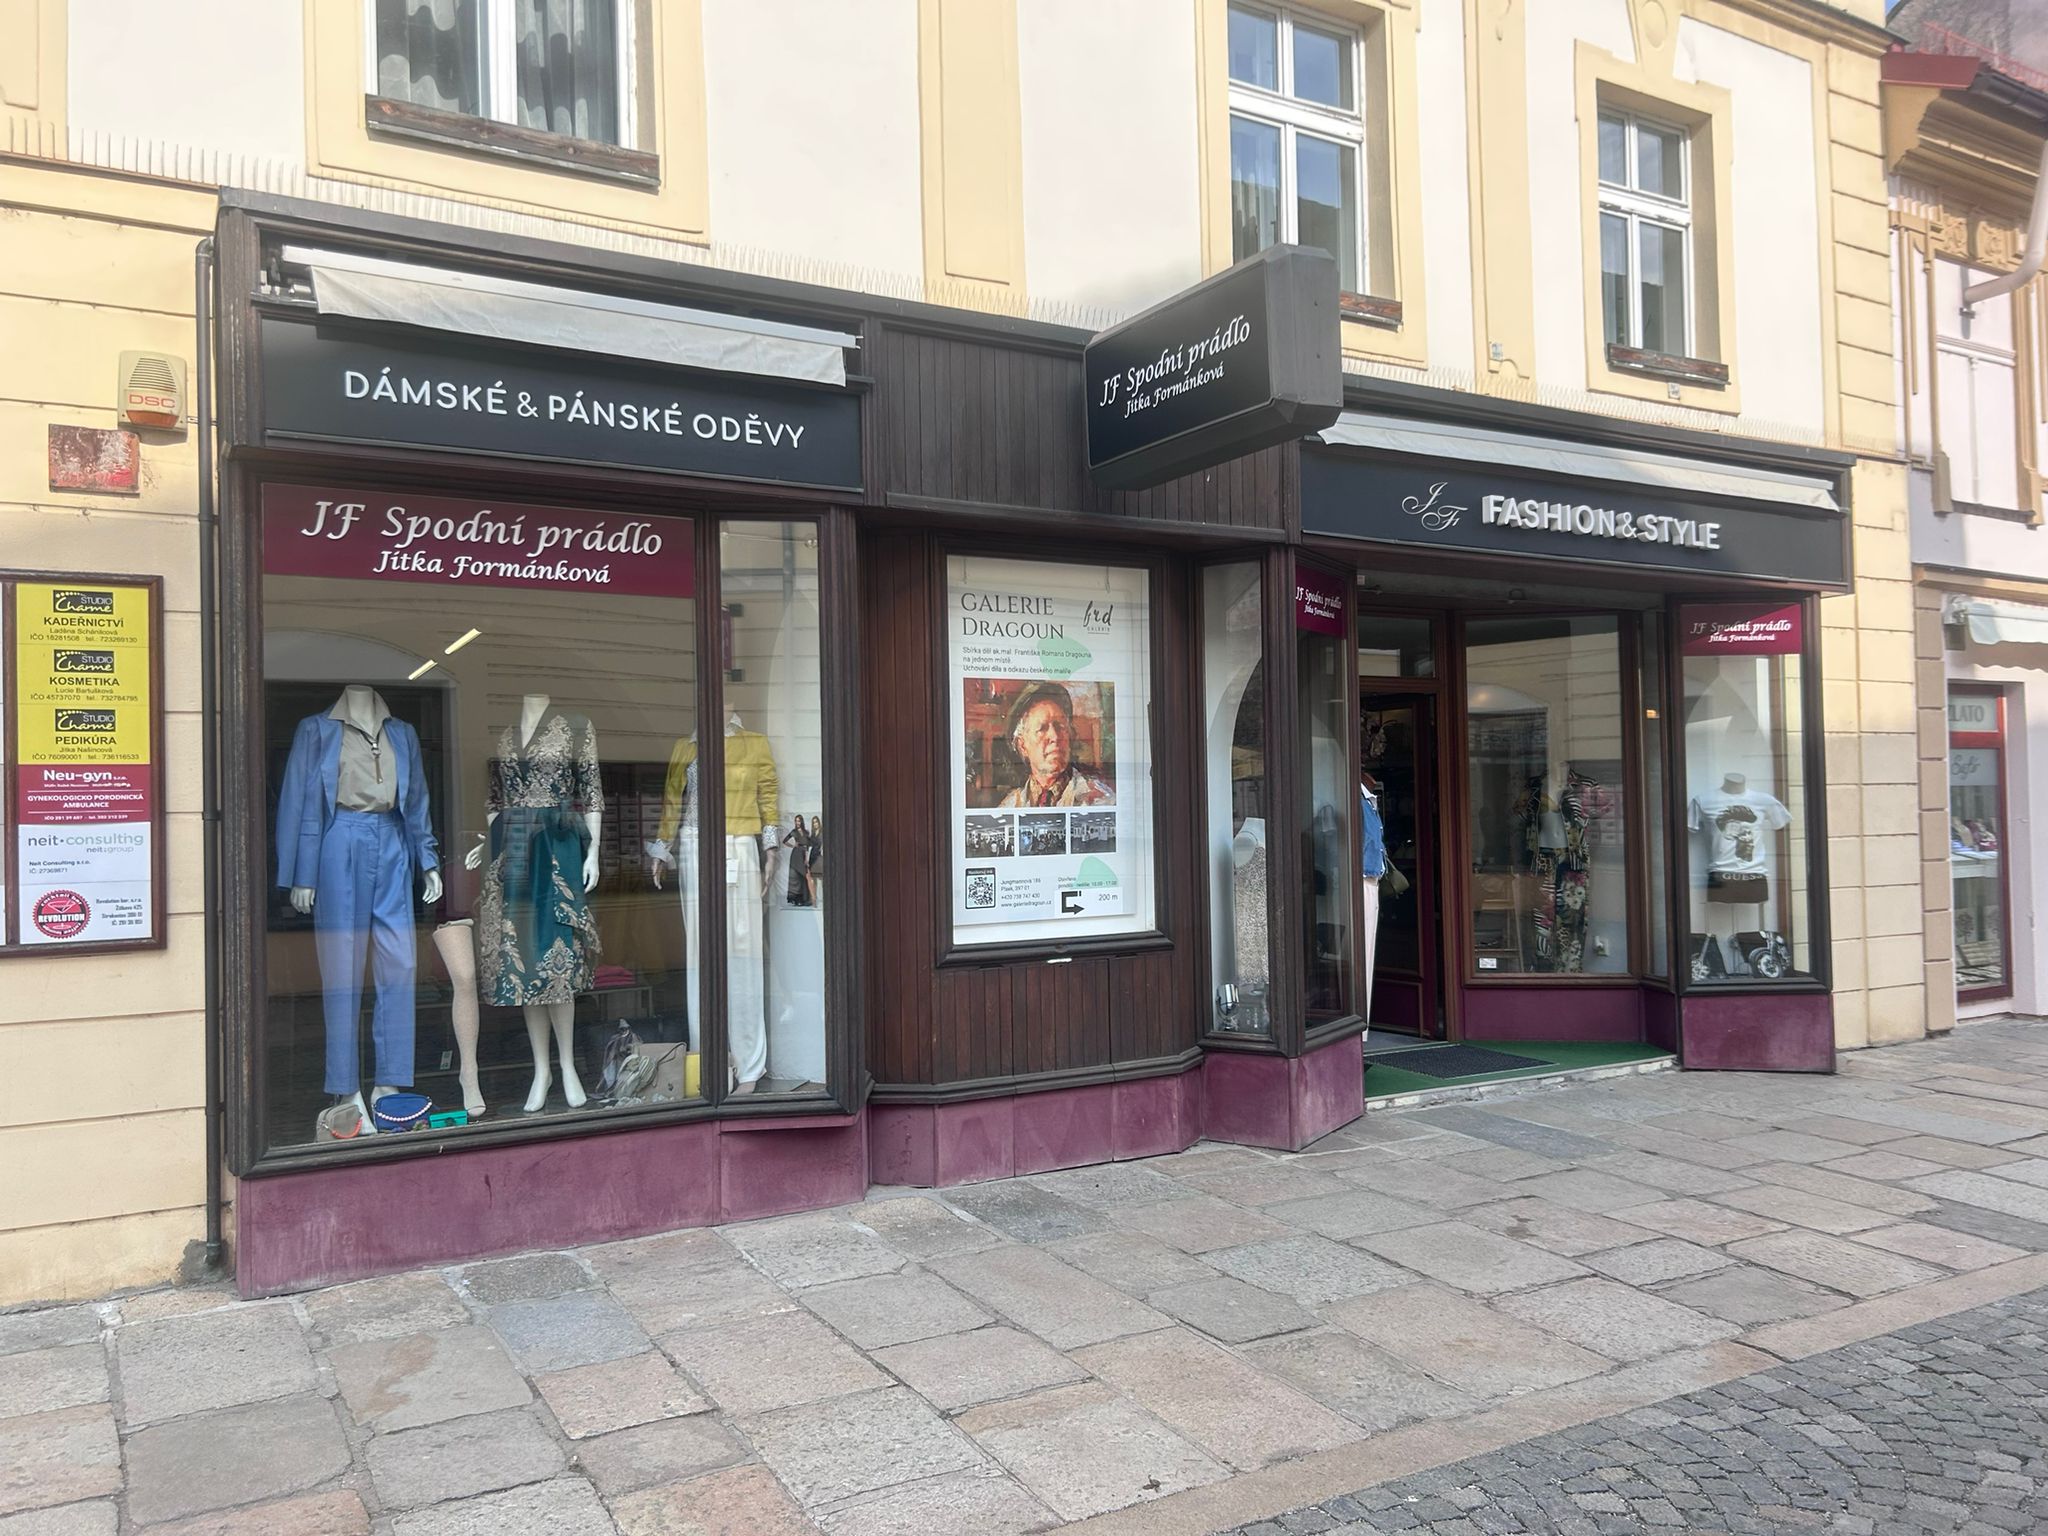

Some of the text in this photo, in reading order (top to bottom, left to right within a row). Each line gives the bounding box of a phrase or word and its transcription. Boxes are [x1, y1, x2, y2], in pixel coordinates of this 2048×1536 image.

[1099, 314, 1251, 407] JF Spodní prádlo
[1124, 361, 1226, 418] Jitka Formánková
[129, 394, 175, 409] DSC
[344, 366, 805, 449] DÁMSKÉ & PÁNSKÉ ODĚVY
[300, 500, 663, 558] JF Spodní prádlo
[1482, 494, 1721, 550] FASHION&STYLE
[372, 551, 612, 585] Jitka Formánková
[55, 597, 112, 613] Charme
[80, 596, 113, 605] STUDIO
[960, 592, 1054, 616] GALERIE
[44, 616, 124, 628] KADEŘNICTVÍ
[962, 617, 1064, 640] DRAGOUN
[1710, 621, 1751, 636] Spodní
[1750, 619, 1792, 635] prádlo
[30, 633, 44, 641] IČO
[56, 656, 113, 671] Charme
[81, 655, 113, 664] STUDIO
[49, 677, 120, 686] KOSMETIKA
[30, 693, 45, 701] IČO
[57, 716, 114, 731] Charme
[82, 714, 114, 723] STUDIO
[55, 734, 117, 745] PEDIKÚRA
[43, 769, 112, 783] Neu-gyn
[27, 793, 144, 802] GYNEKOLOGICKO PORODNICKÁ
[1098, 893, 1110, 901] 200
[38, 913, 85, 923] REVOLUTION
